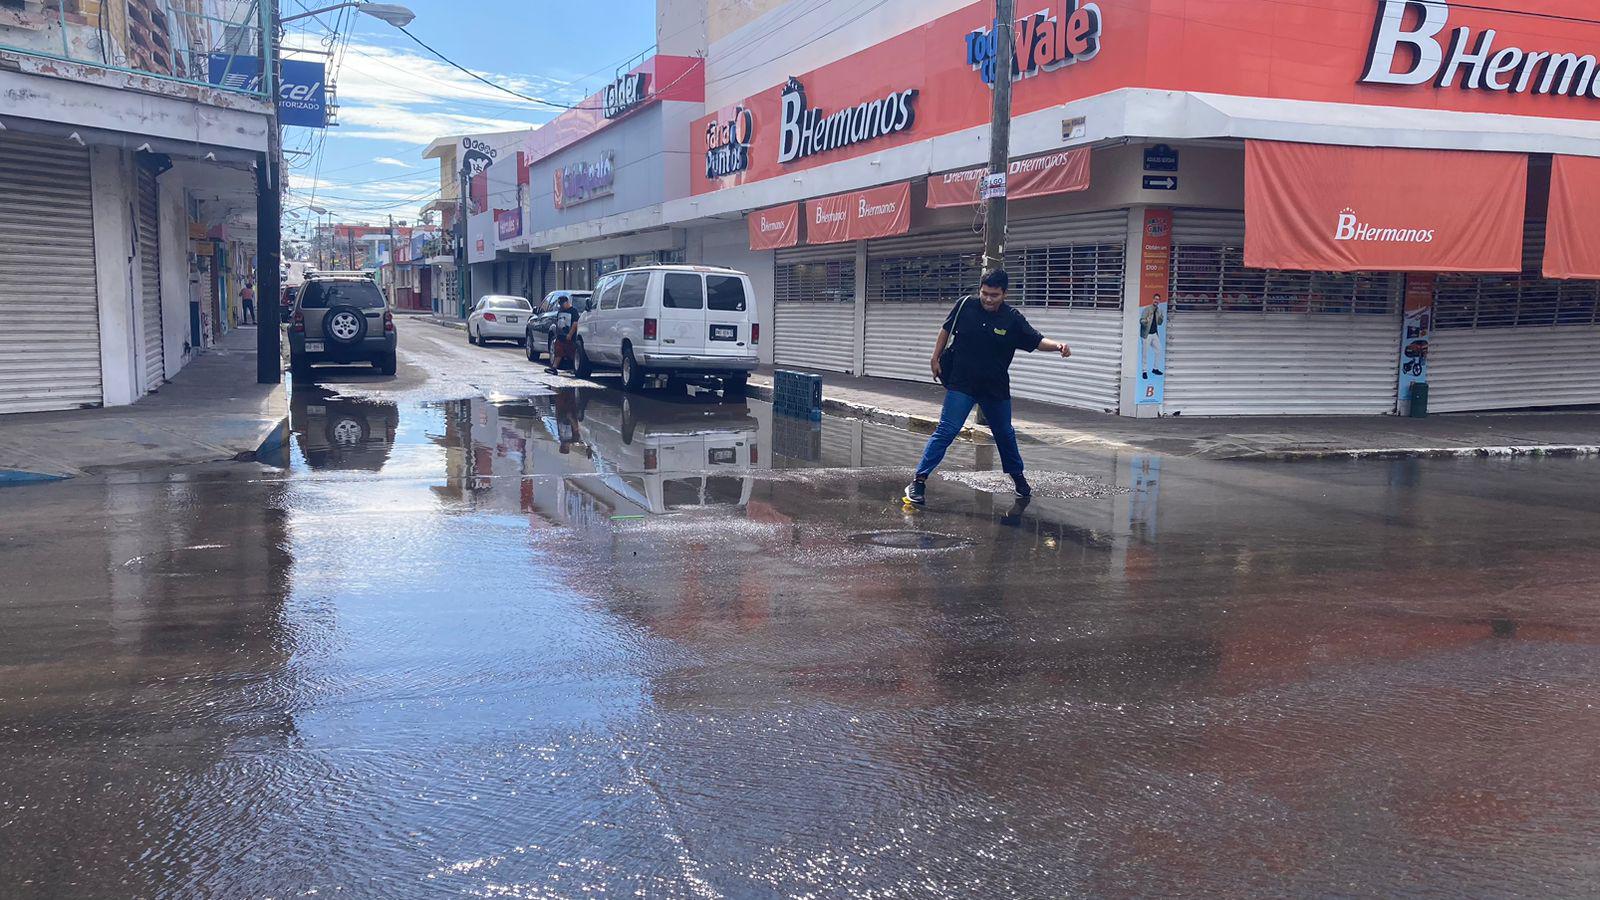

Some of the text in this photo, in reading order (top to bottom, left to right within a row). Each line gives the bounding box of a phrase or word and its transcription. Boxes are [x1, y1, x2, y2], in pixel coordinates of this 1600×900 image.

[965, 0, 1092, 73] Tod Vale
[279, 101, 320, 111] TORIZADO
[1146, 385, 1155, 397] B
